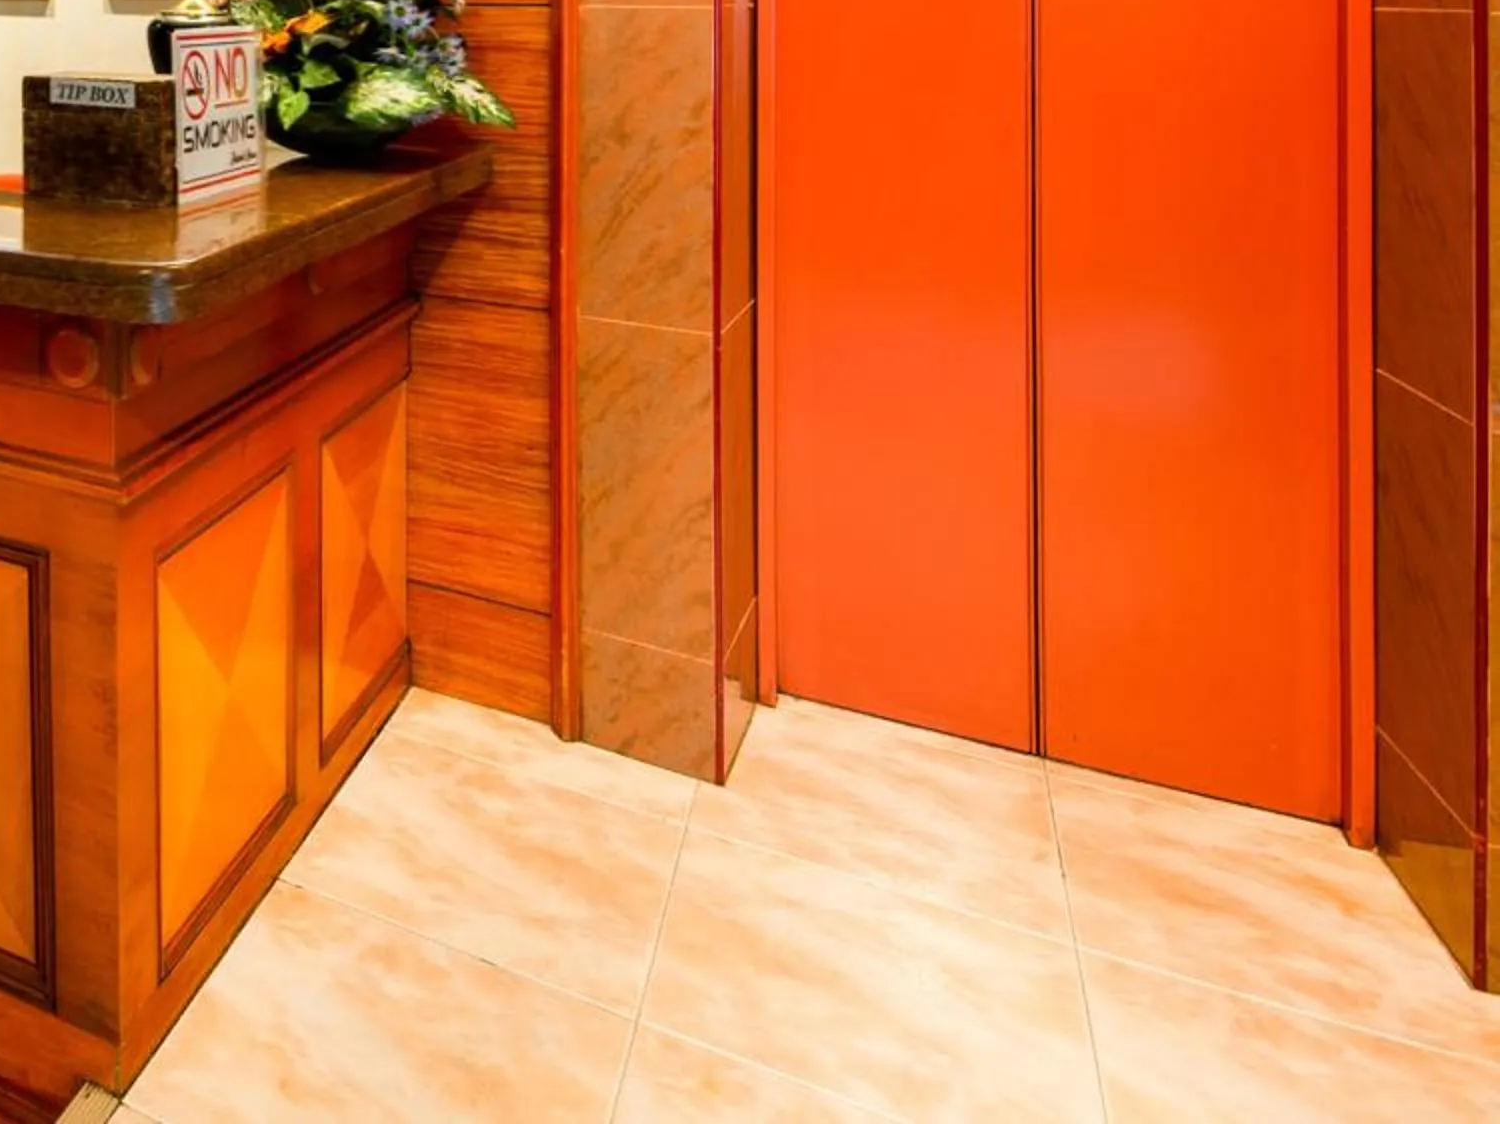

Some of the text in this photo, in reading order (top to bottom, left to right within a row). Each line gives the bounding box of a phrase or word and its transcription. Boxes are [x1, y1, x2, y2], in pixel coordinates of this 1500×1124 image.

[214, 47, 248, 98] NO
[57, 82, 130, 105] TIP BOX
[183, 114, 256, 154] SMOKING
